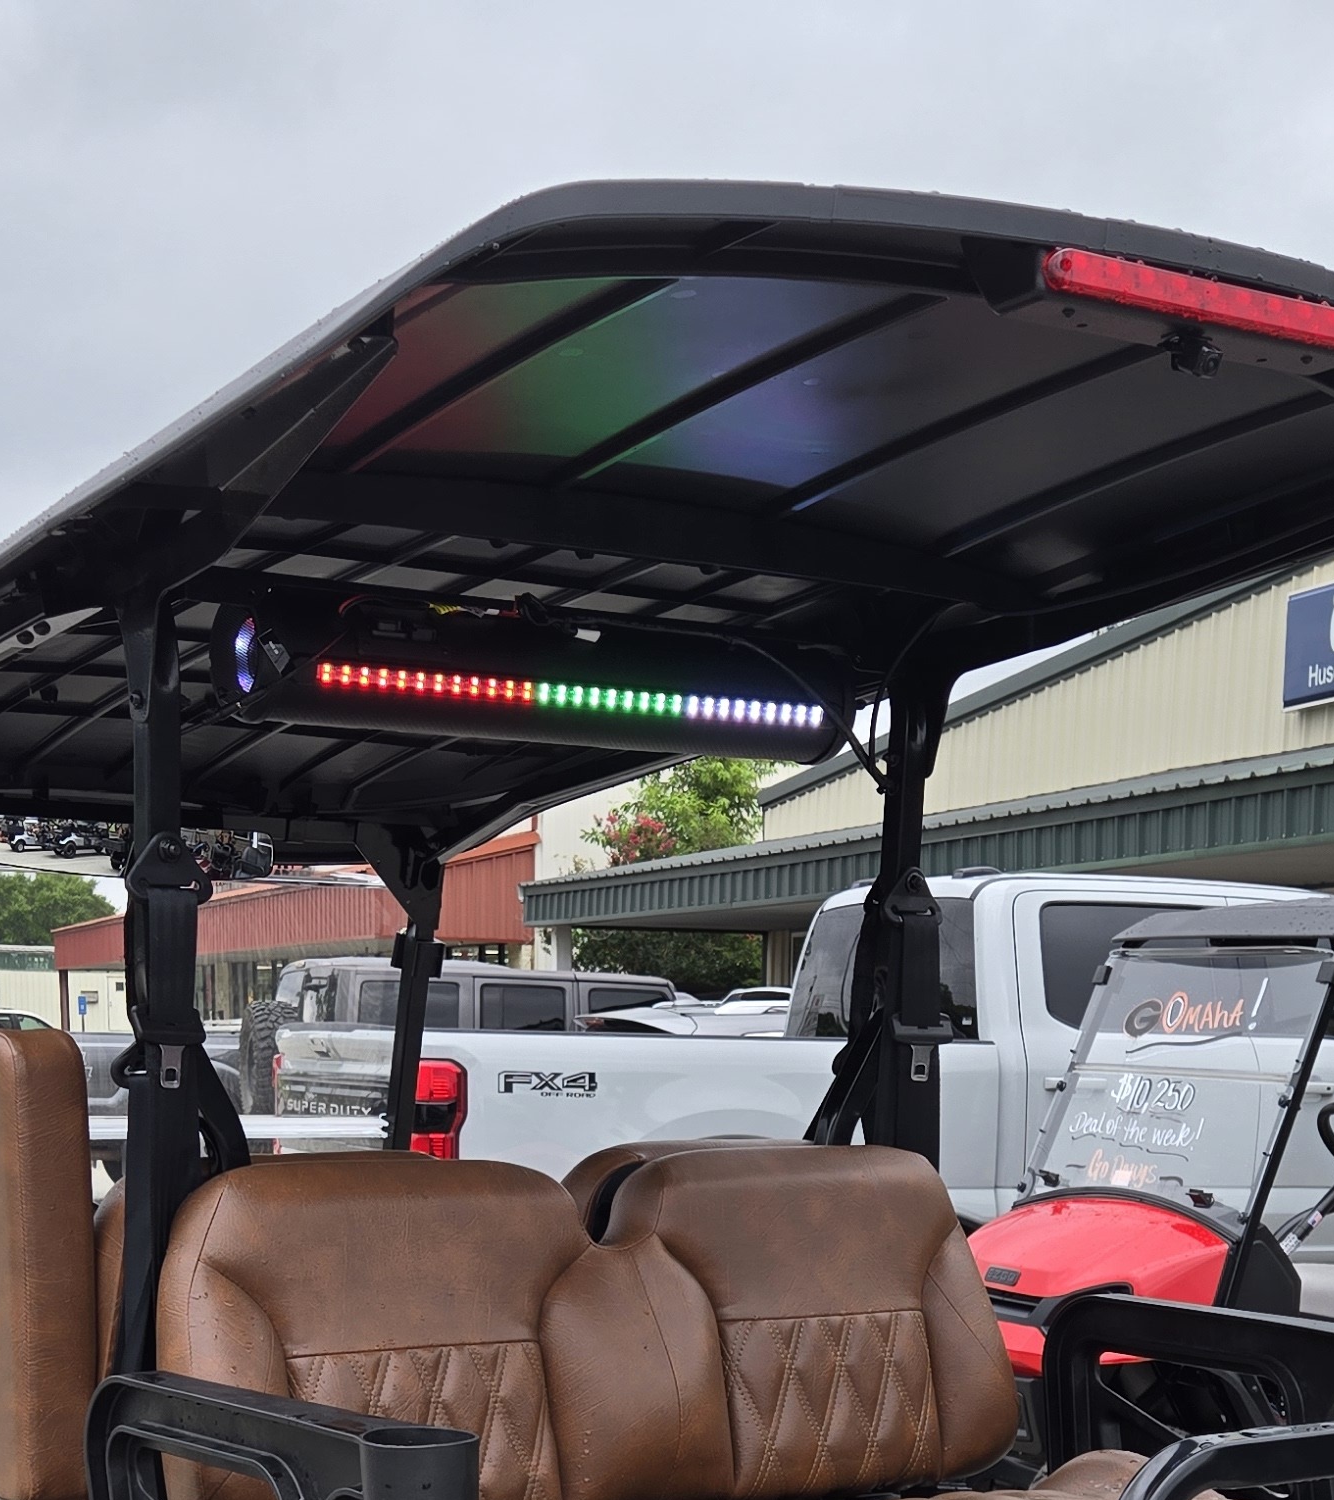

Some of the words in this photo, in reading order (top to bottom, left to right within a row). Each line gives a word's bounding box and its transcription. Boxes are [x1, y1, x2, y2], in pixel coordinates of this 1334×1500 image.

[498, 1070, 597, 1094] FX4
[1111, 1073, 1196, 1114] $10,250
[287, 1098, 326, 1114] SUPER
[329, 1103, 372, 1116] DUTY
[1069, 1111, 1106, 1134] Deal
[1106, 1114, 1123, 1136] of
[1123, 1117, 1148, 1144] the
